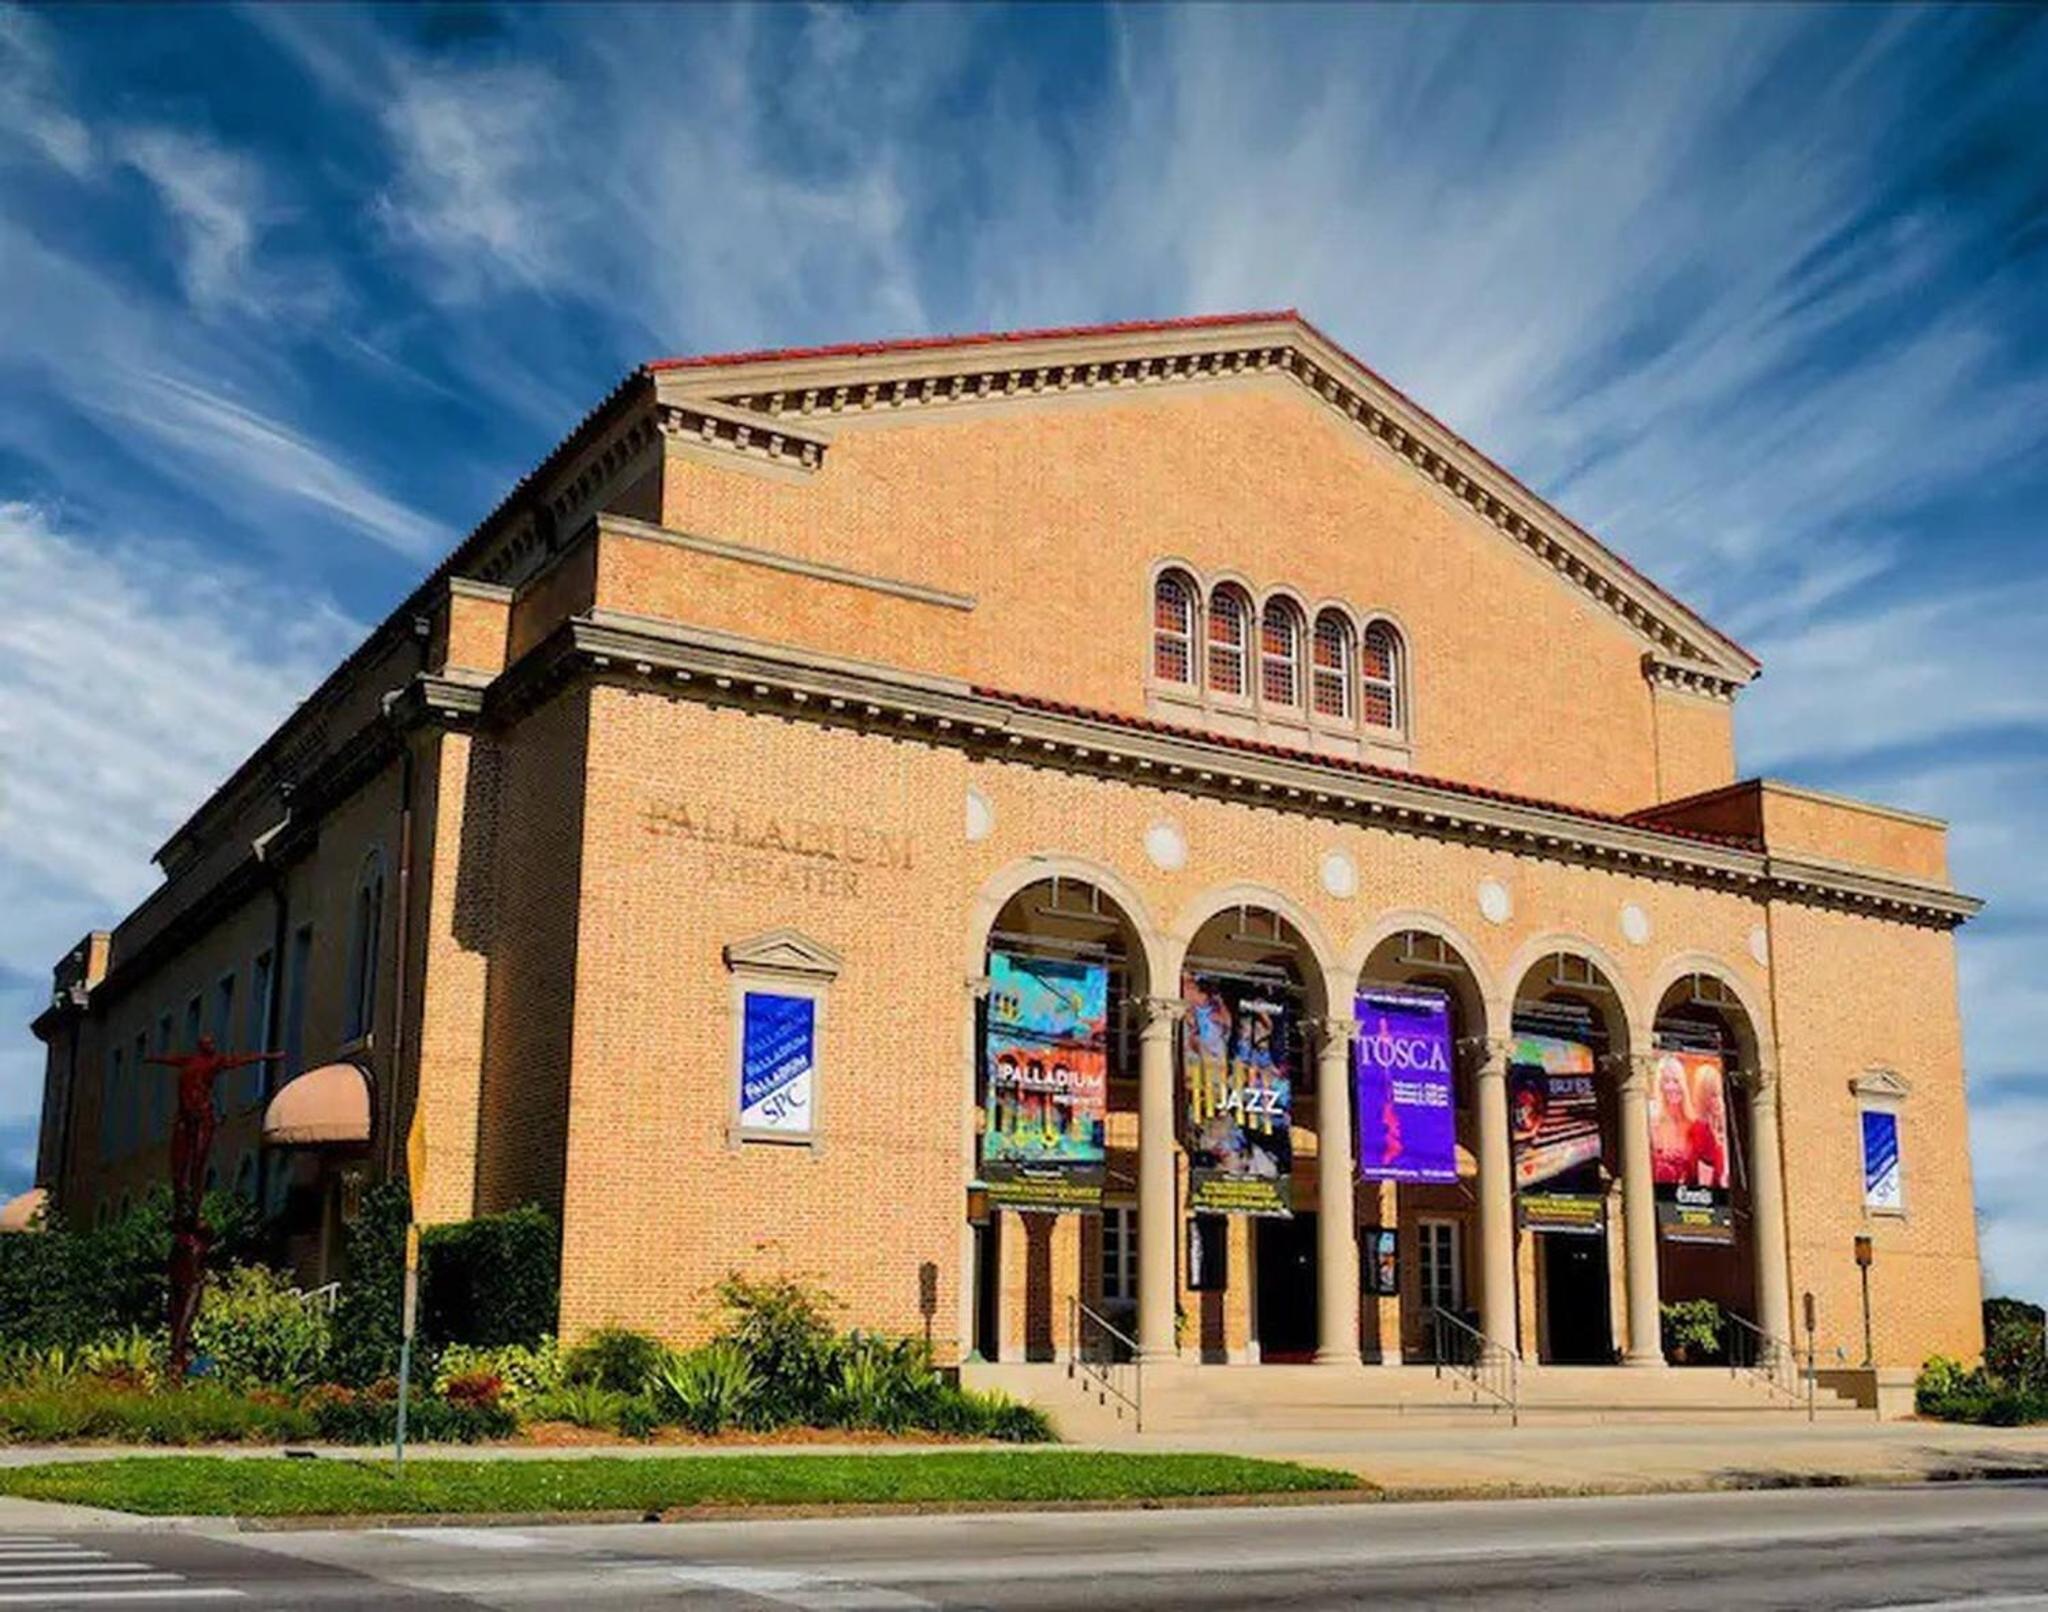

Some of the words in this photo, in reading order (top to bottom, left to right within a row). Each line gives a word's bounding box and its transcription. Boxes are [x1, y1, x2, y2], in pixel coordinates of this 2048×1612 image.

[639, 799, 915, 870] PALLADIUM
[1360, 1036, 1448, 1072] TOSCA
[1001, 1061, 1102, 1089] PALLADIUM
[761, 1081, 805, 1125] SPC
[1216, 1087, 1283, 1114] JAZZ
